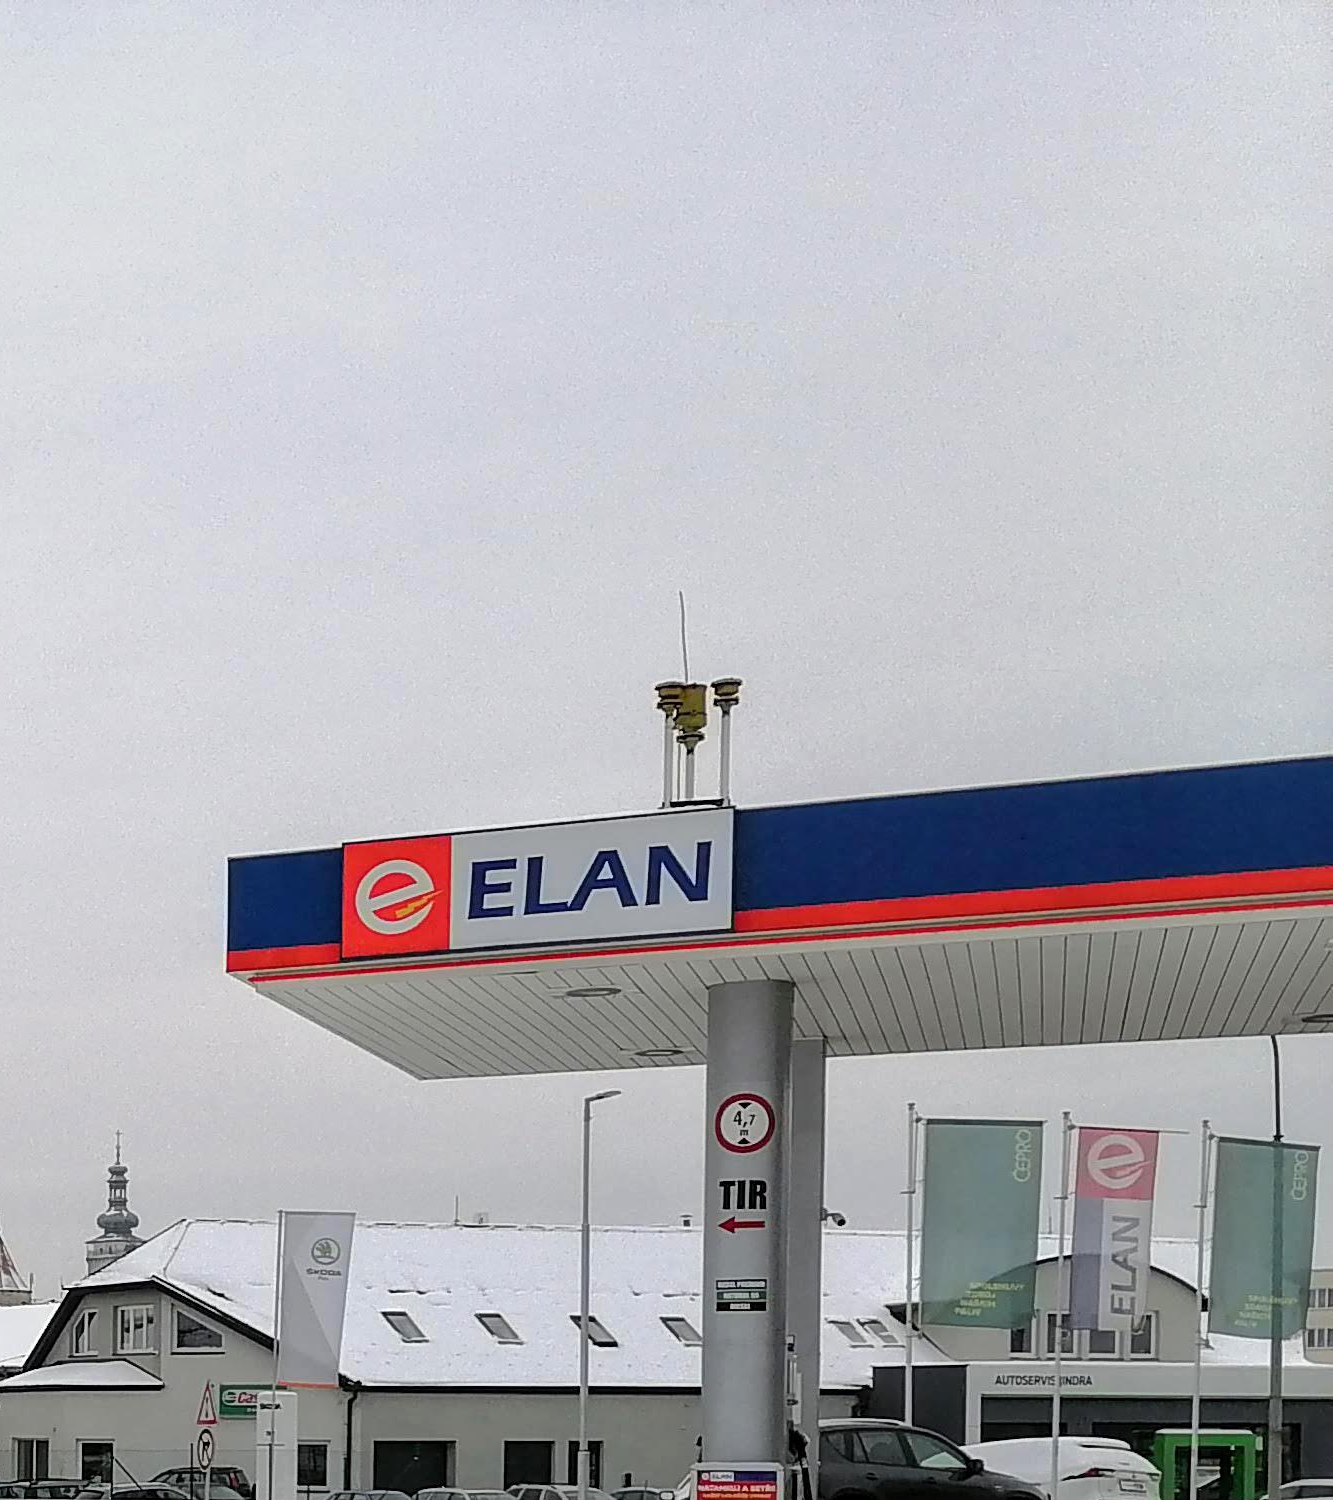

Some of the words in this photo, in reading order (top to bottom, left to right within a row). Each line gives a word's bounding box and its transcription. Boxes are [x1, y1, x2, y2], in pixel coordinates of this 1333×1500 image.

[467, 841, 712, 920] ELAN
[733, 1110, 756, 1128] 4,7
[739, 1129, 749, 1137] m
[1013, 1129, 1032, 1182] ČEPRO
[719, 1180, 767, 1210] TIR
[1291, 1151, 1309, 1201] ČEPRO
[1110, 1215, 1140, 1315] ELAN
[995, 1375, 1056, 1386] AUTOSERVIS
